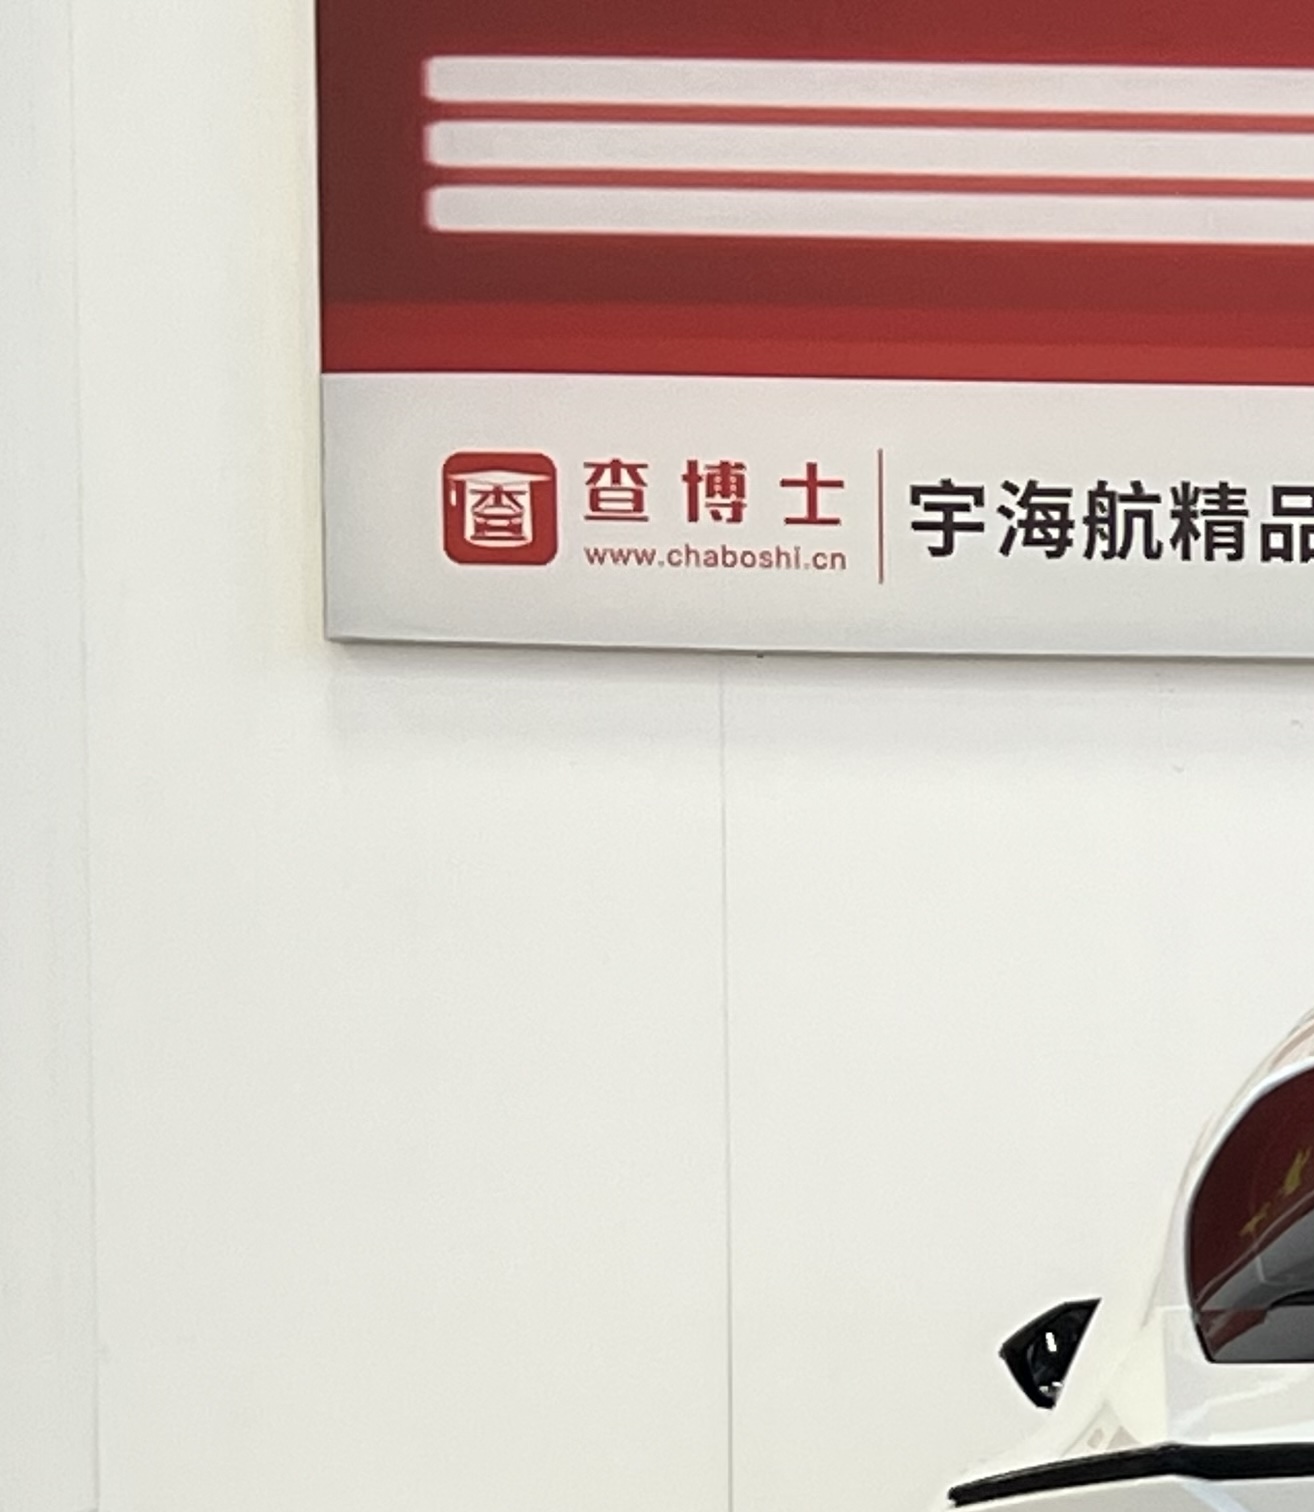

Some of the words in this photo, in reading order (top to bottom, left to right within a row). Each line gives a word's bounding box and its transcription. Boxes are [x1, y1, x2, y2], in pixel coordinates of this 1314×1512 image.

[584, 458, 845, 527] 查博士
[583, 544, 848, 570] www.chaboshi.cn
